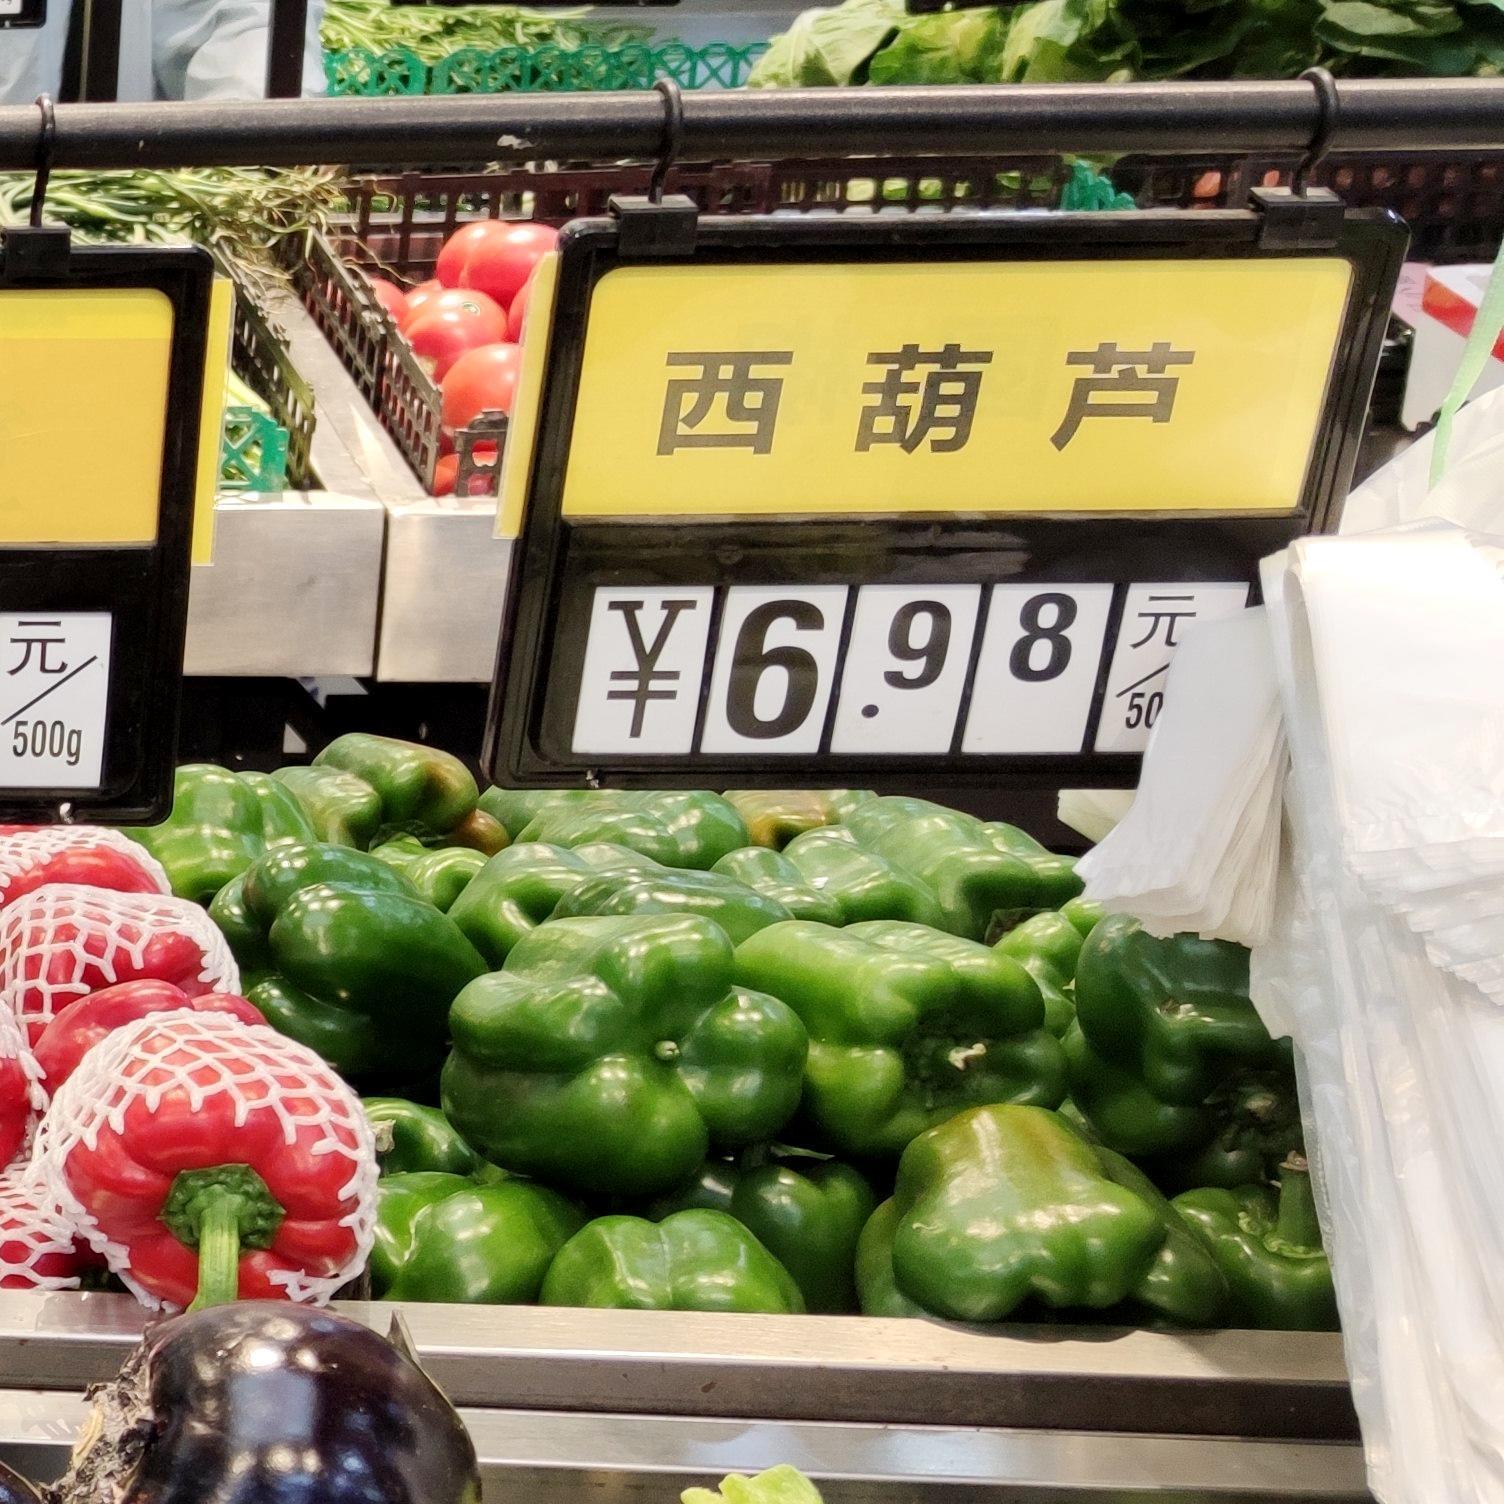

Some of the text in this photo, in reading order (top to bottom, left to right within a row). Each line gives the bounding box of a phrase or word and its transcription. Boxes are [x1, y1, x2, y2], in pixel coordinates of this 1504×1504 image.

[656, 341, 1197, 457] 西葫芦
[606, 591, 1078, 740] ¥6.98
